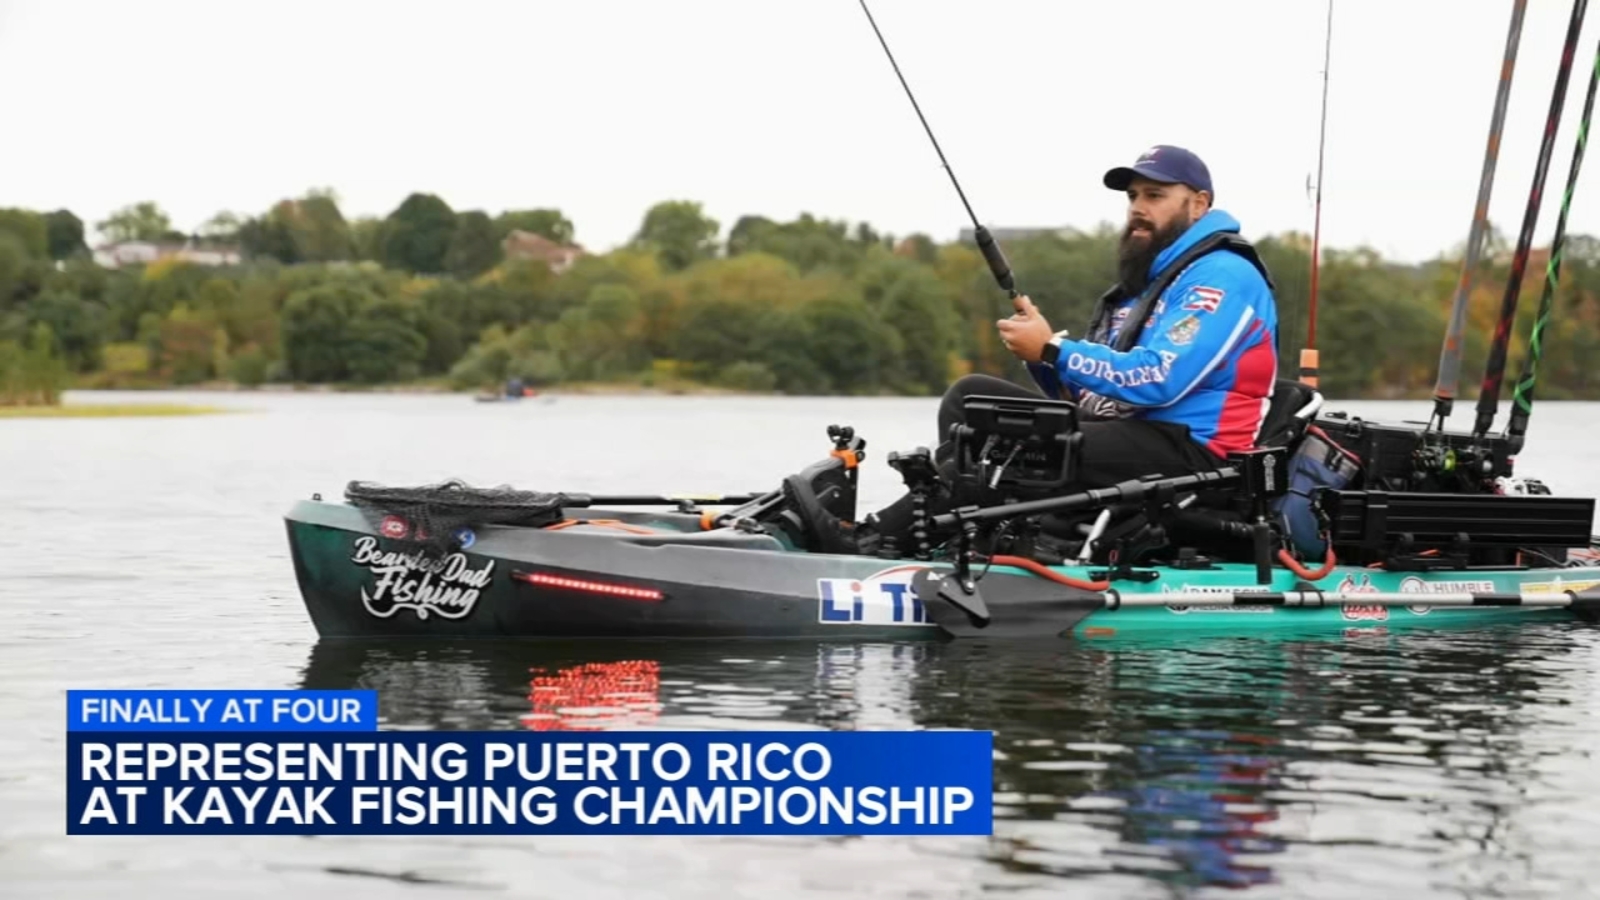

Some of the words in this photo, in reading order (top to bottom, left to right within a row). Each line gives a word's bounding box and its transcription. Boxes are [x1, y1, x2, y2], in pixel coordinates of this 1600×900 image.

[1068, 352, 1114, 383] RICO
[351, 536, 447, 574] Bearded
[440, 552, 495, 588] Dad
[363, 565, 480, 619] Fishing
[820, 580, 863, 622] Li
